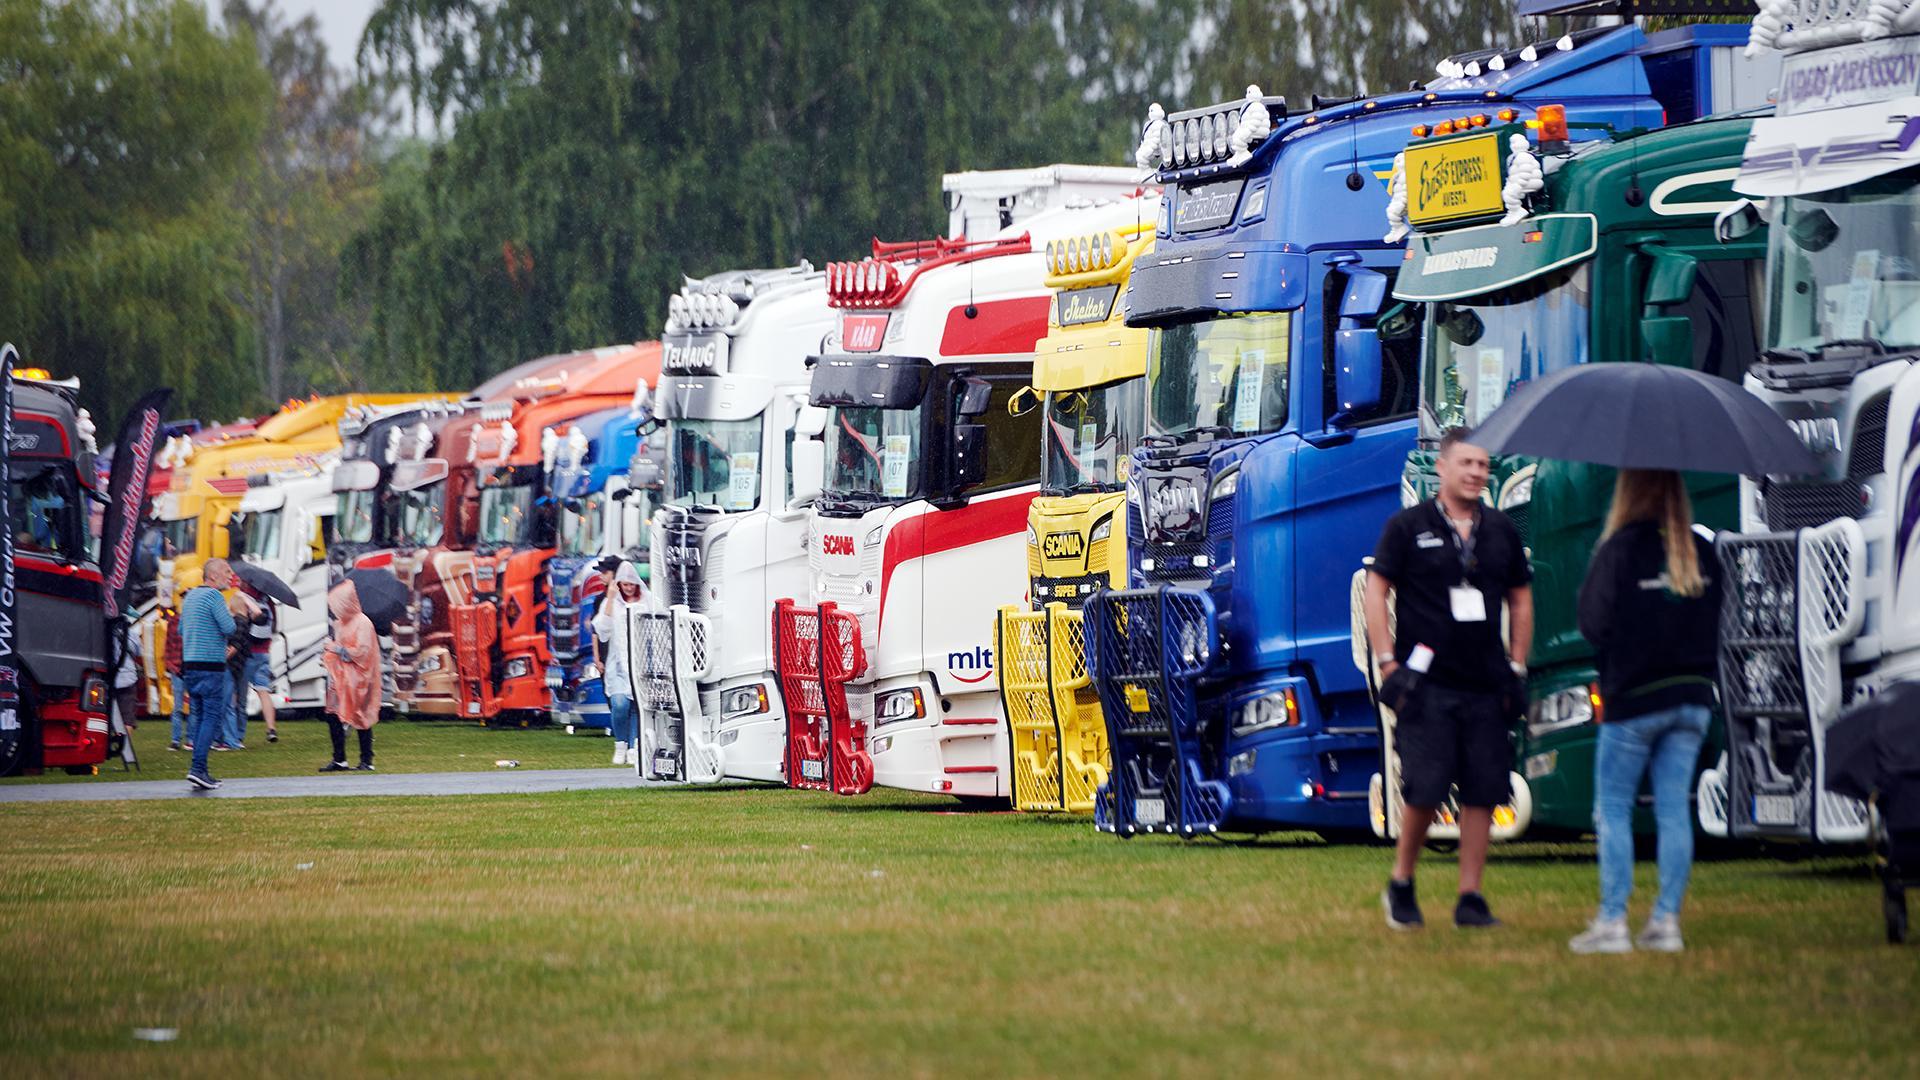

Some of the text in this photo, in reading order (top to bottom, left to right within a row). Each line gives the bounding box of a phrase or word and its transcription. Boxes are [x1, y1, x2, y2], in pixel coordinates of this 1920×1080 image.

[1064, 294, 1105, 322] Shelter
[661, 342, 715, 368] TELHAUG
[734, 476, 751, 490] 105
[666, 545, 701, 567] SCANIA
[823, 534, 855, 556] SCANIA
[1046, 534, 1081, 557] SCANIA
[1054, 584, 1077, 598] SUPER
[948, 645, 993, 669] mlt
